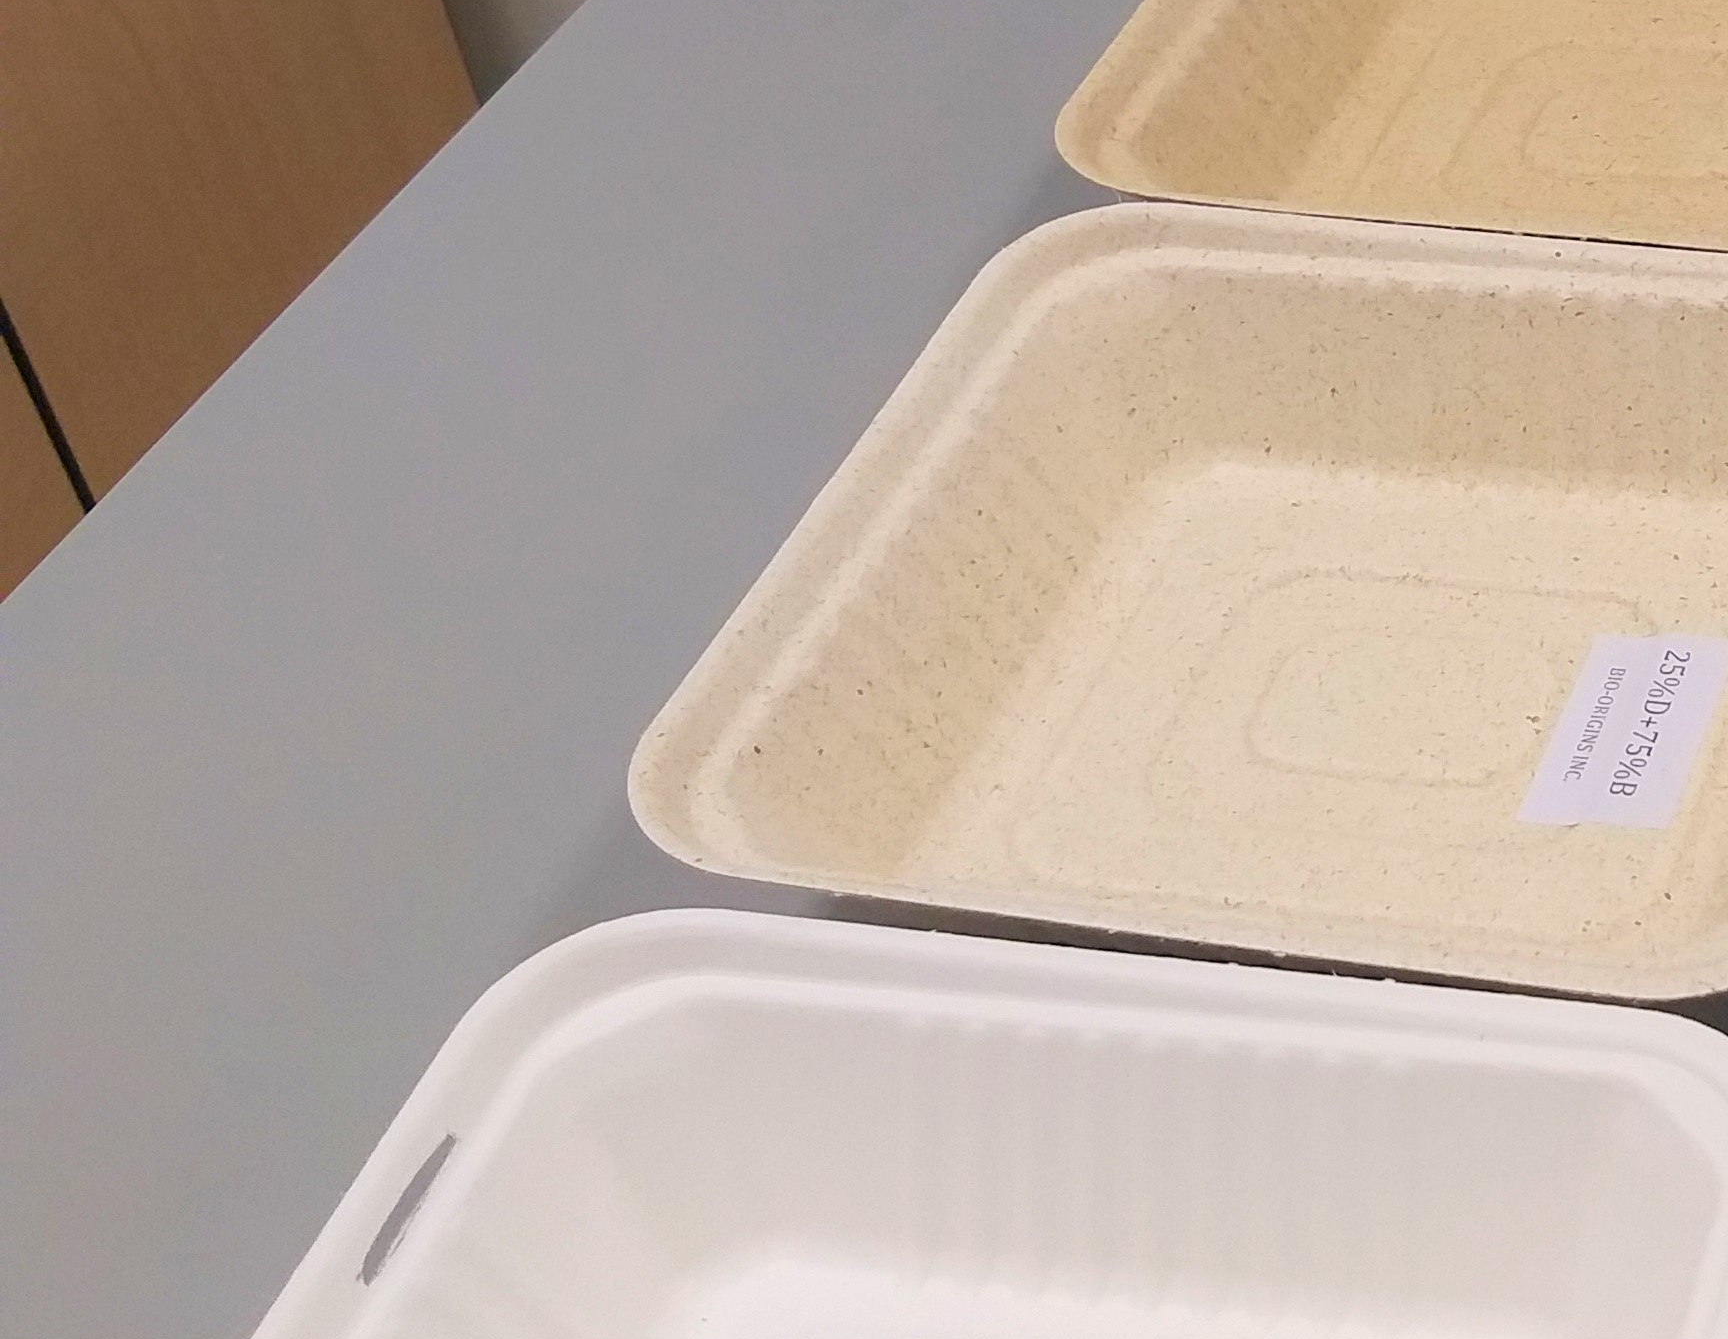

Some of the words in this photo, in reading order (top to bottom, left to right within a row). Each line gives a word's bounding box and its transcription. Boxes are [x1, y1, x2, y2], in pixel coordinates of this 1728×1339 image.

[1577, 667, 1627, 753] BIO-ORIGINS
[1609, 649, 1691, 797] 25%D+75%B
[1563, 755, 1590, 782] INC.
